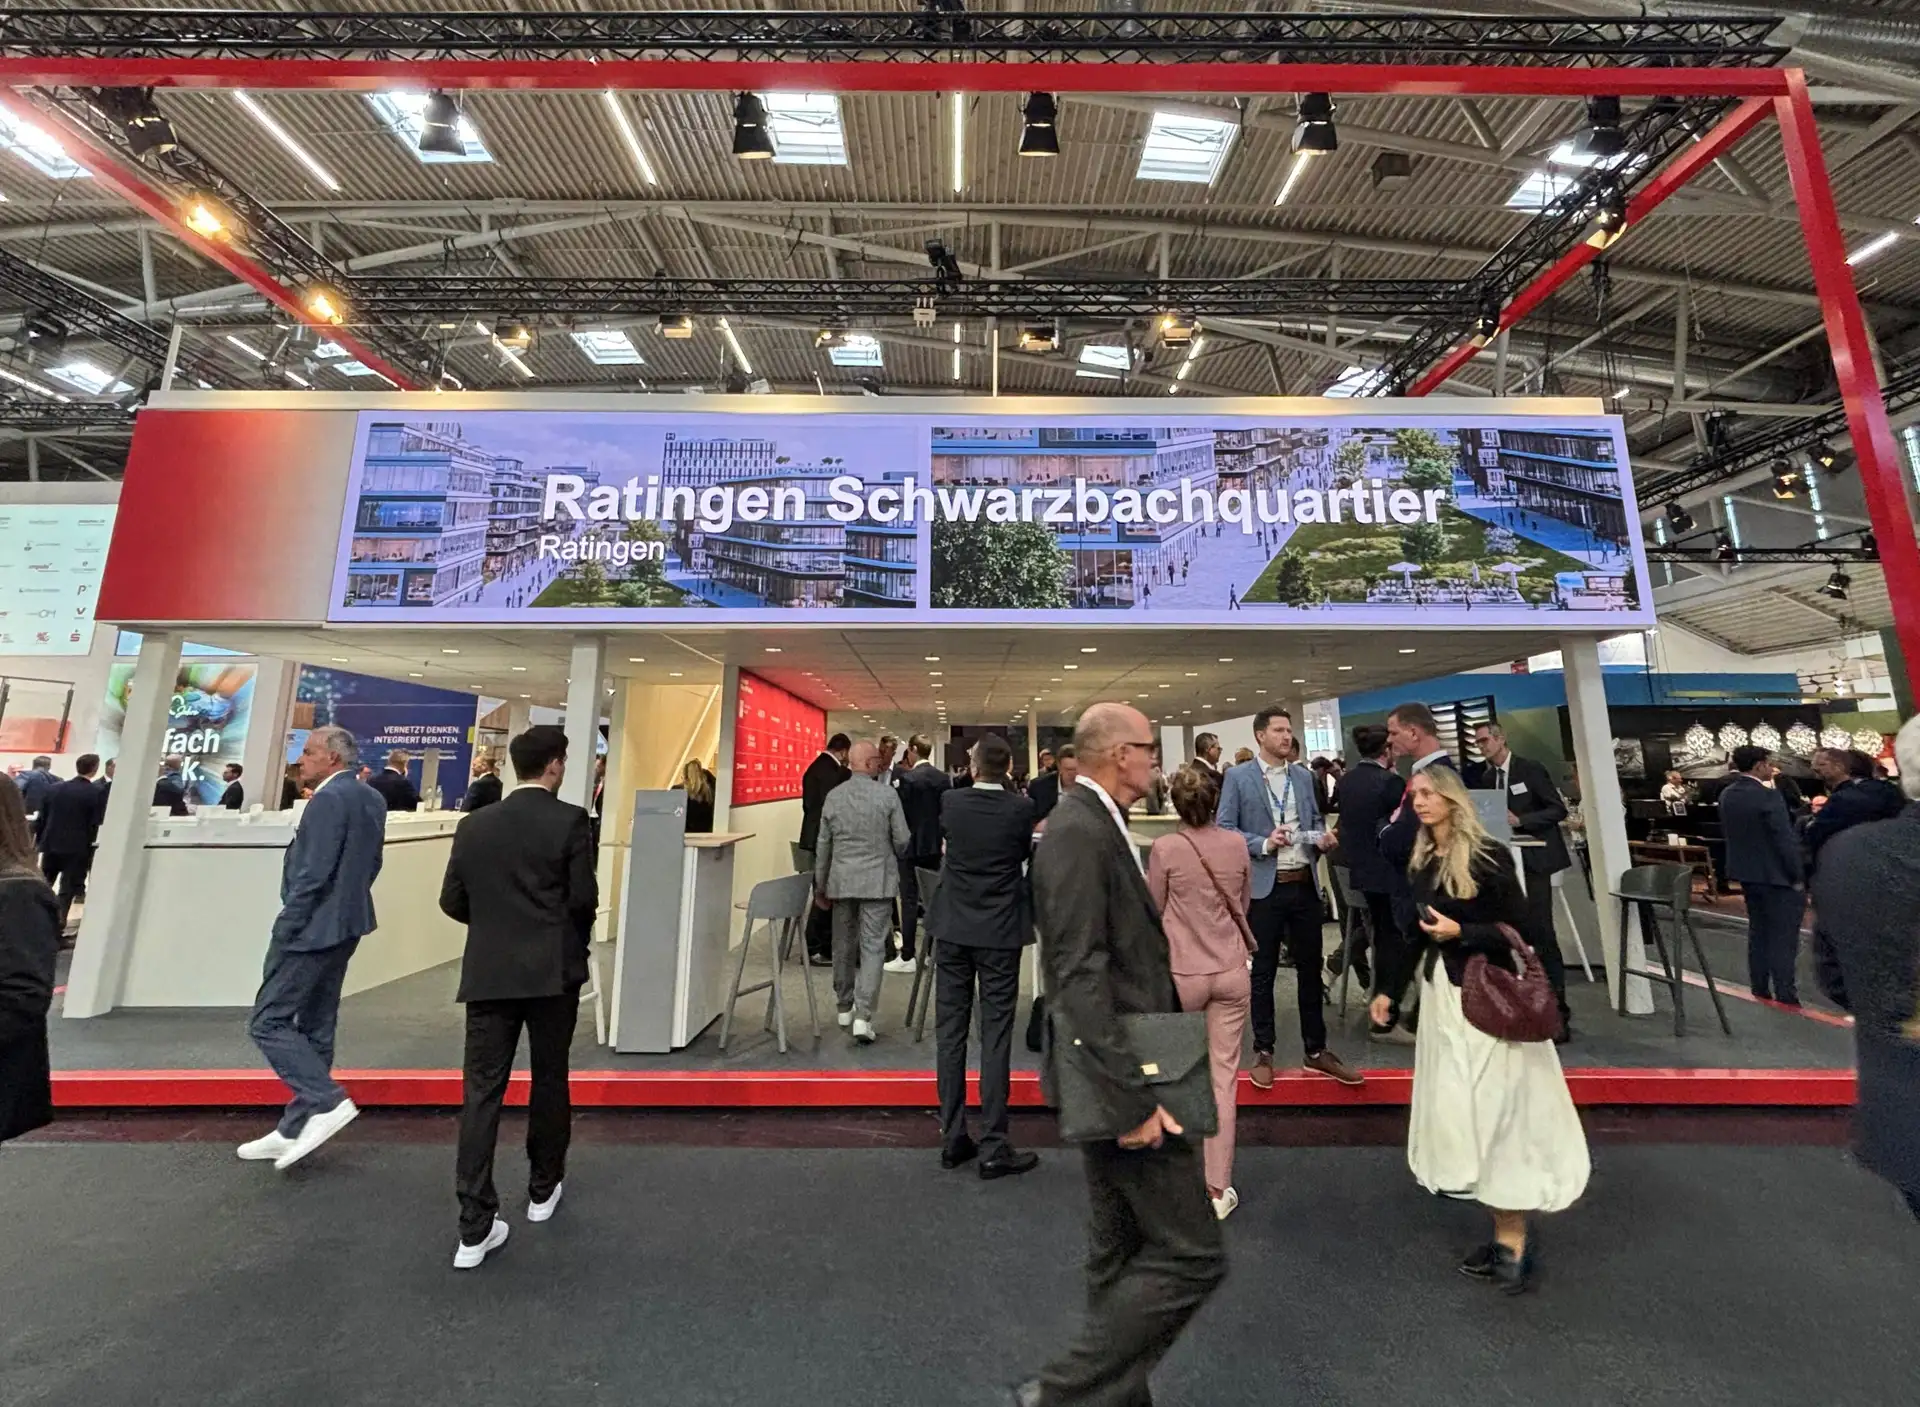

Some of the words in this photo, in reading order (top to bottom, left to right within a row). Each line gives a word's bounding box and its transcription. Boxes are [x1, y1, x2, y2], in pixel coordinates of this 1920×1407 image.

[543, 474, 806, 533] Ratingen
[826, 475, 1446, 534] Schwarzbachquartier
[538, 535, 665, 566] Ratingen
[383, 726, 426, 734] VERNETZT
[426, 726, 461, 734] DENKEN.
[373, 736, 419, 744] INTEGRIERT
[421, 736, 460, 744] BERATEN.
